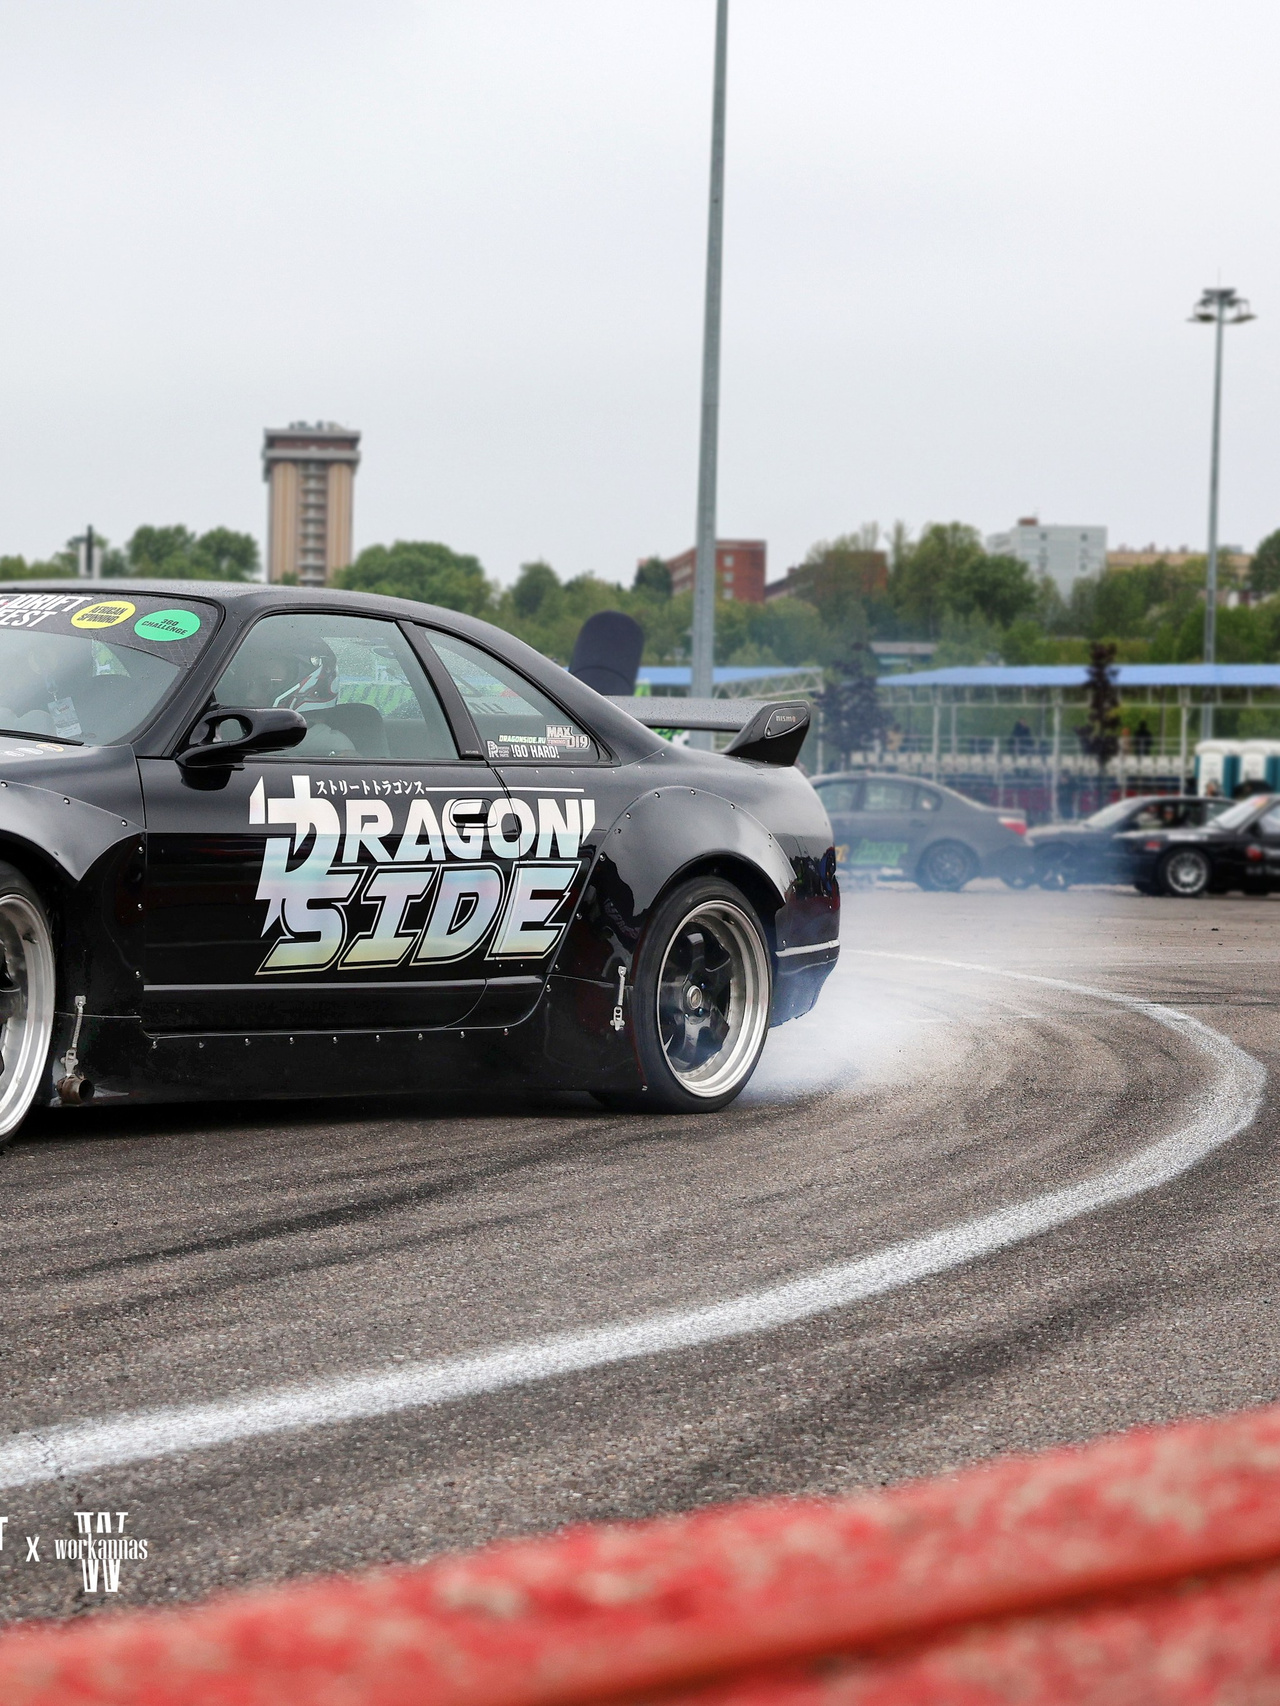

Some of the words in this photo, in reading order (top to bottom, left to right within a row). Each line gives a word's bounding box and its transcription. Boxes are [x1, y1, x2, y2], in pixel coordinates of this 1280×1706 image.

[14, 594, 93, 612] DRIFT
[142, 620, 188, 636] CHALLENGE
[547, 726, 571, 738] MAX
[498, 735, 546, 744] DRAGONSIDE.RU
[511, 745, 528, 758] !GO
[530, 745, 560, 758] HARD!
[255, 860, 582, 975] SIDE
